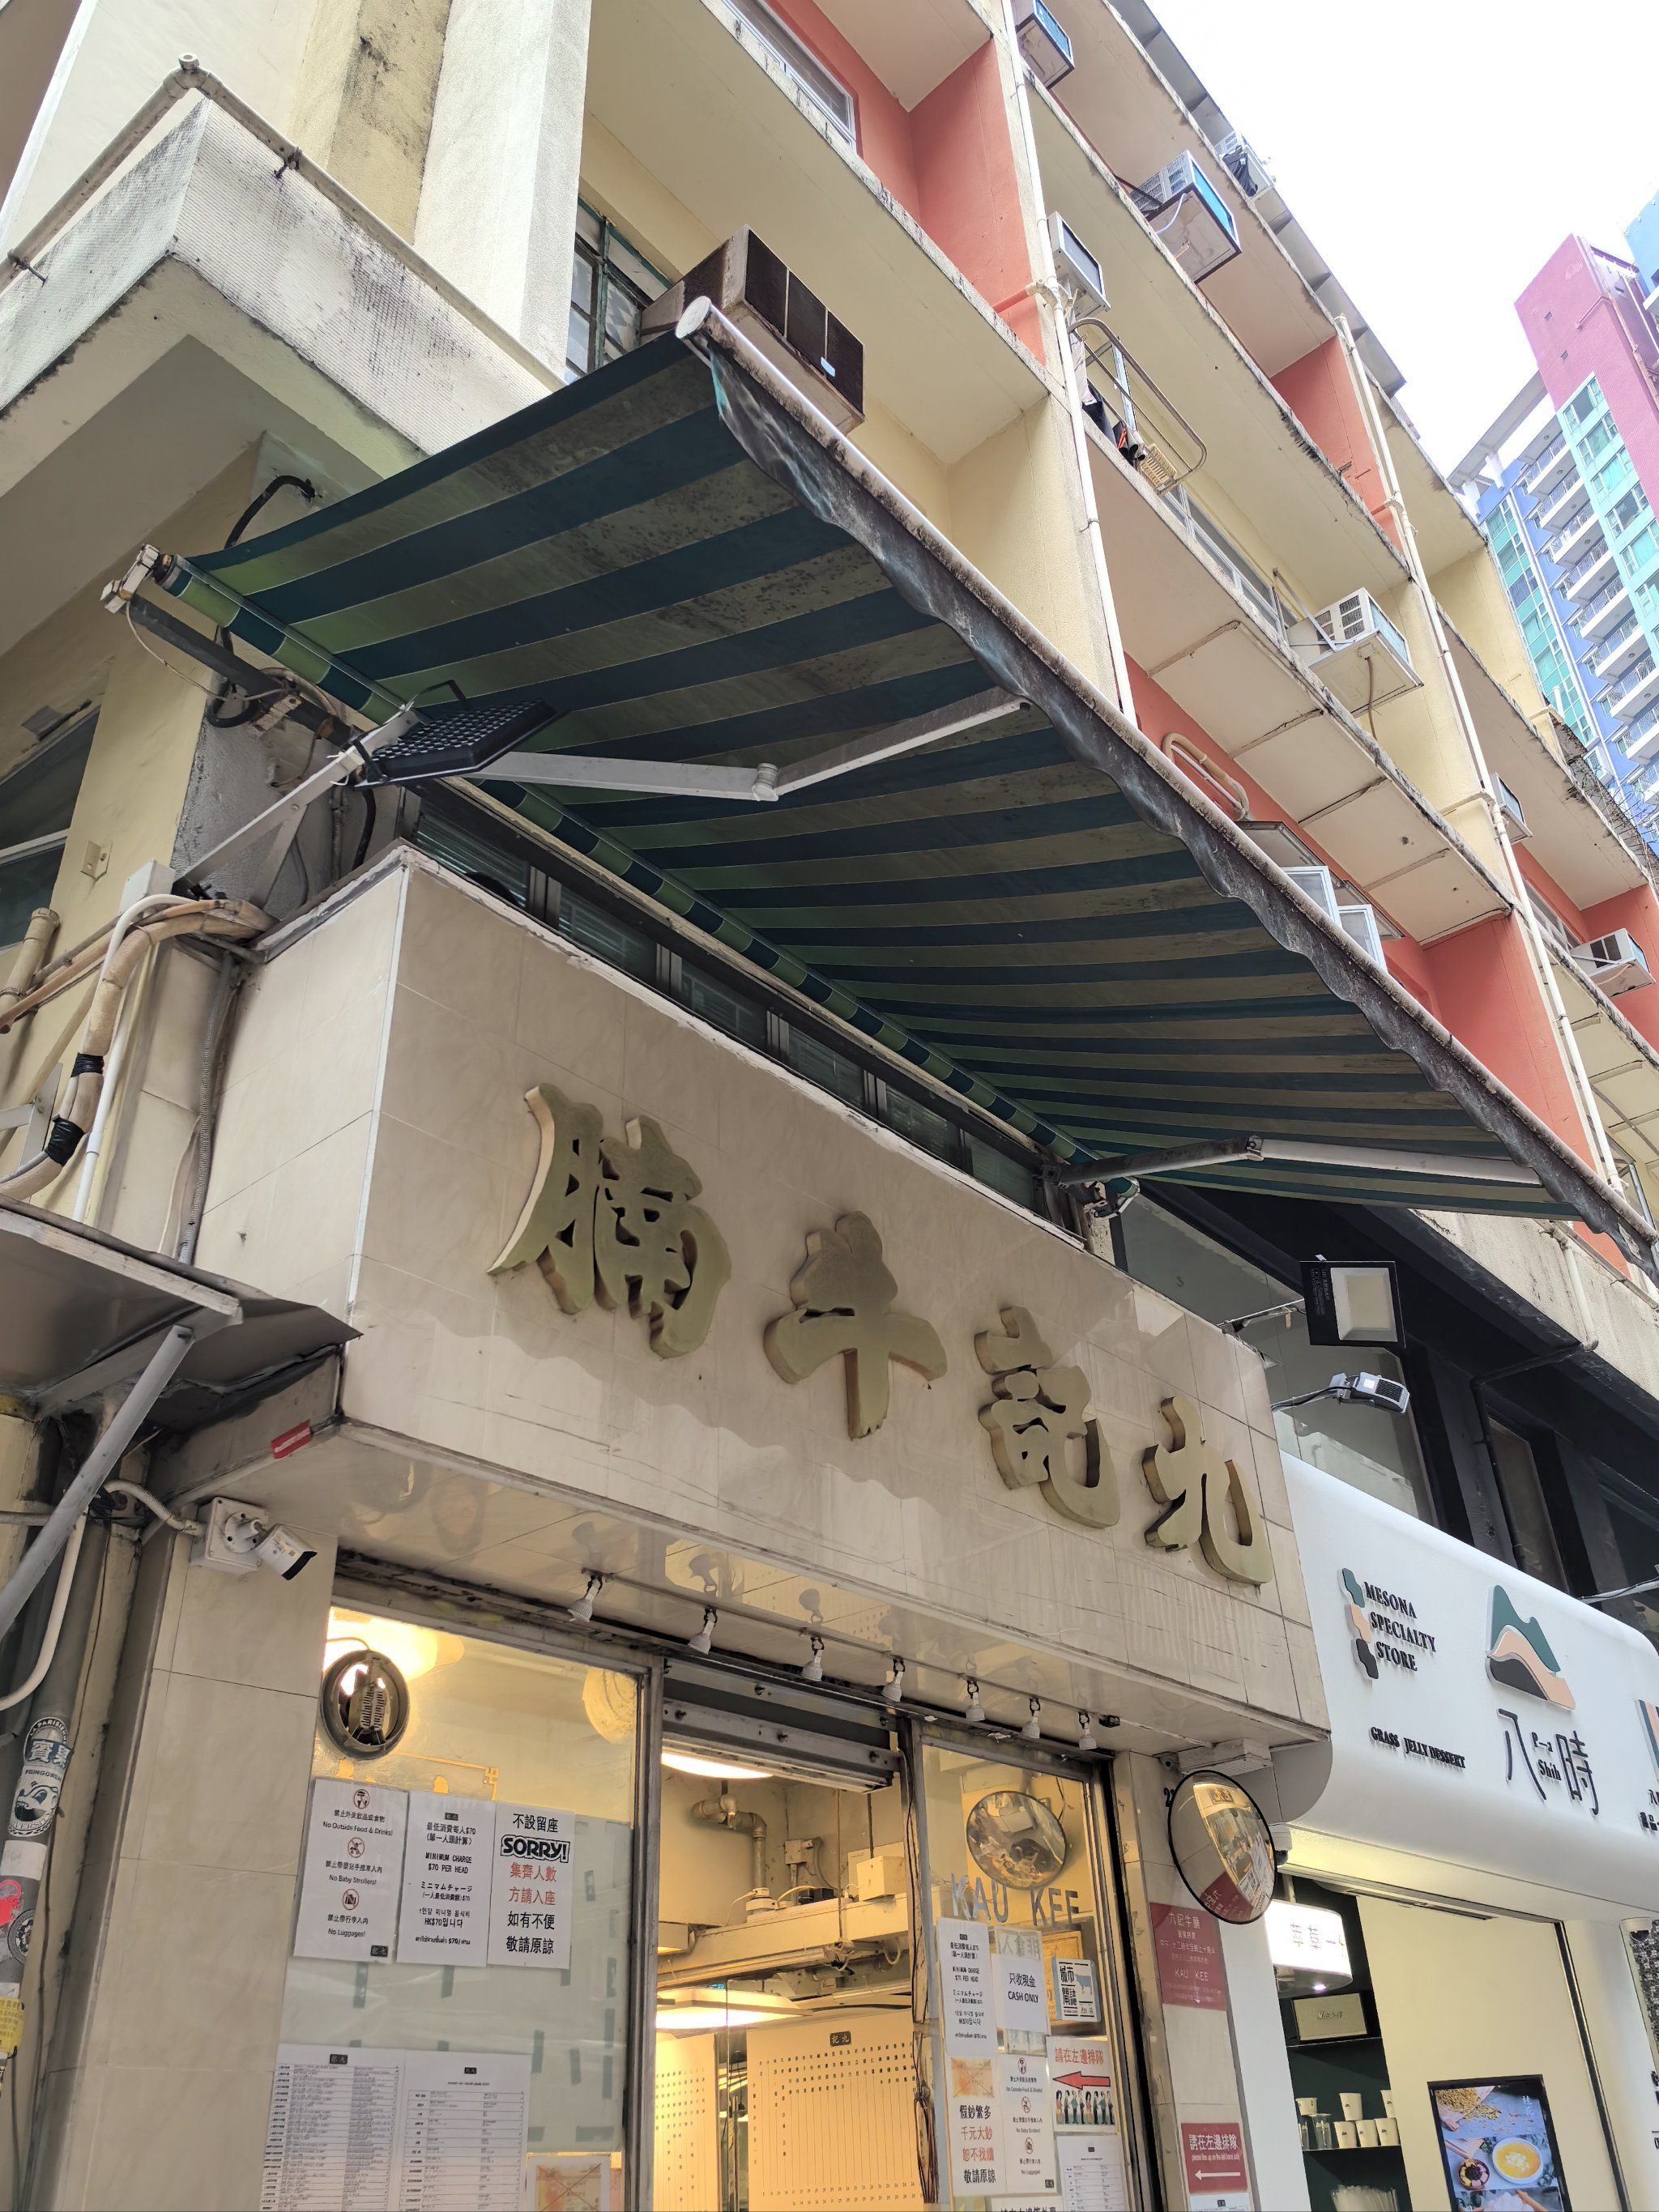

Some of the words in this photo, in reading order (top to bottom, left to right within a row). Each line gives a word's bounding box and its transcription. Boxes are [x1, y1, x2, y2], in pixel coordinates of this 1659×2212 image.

[1364, 1582, 1417, 1619] MESONA
[1370, 1611, 1436, 1652] SPECIALTY
[1375, 1641, 1418, 1672] STORE
[1371, 1726, 1401, 1748] GRASS
[1403, 1737, 1430, 1757] JELLY
[1429, 1745, 1466, 1769] DESSERT
[1498, 1708, 1599, 1815] 八時
[1538, 1759, 1562, 1781] Shih
[332, 1822, 353, 1831] Outside
[354, 1825, 368, 1833] Food
[374, 1828, 393, 1836] Drinks!
[513, 1813, 559, 1833] 不設留座
[502, 1836, 569, 1861] SORRY!
[425, 1852, 450, 1862] MINIMUM
[452, 1855, 472, 1864] CHARGE
[428, 1863, 439, 1871] $70
[441, 1865, 452, 1873] PER
[454, 1865, 469, 1873] HEAD
[510, 1861, 557, 1883] 集齊人數
[339, 1875, 352, 1884] Baby
[352, 1877, 377, 1886] Strollers!
[421, 1881, 473, 1892] ミニマムチャージ
[509, 1886, 556, 1906] 方請入座
[951, 1873, 1009, 1924] KAU
[507, 1910, 556, 1930] 如有不便
[337, 1929, 365, 1938] Luggages!
[505, 1935, 554, 1954] 敬請原諒
[1009, 1972, 1036, 1988] 只收現金
[1175, 1969, 1188, 1978] KAU
[1195, 1971, 1209, 1981] KEE
[1008, 1991, 1023, 2001] CASH
[1024, 1993, 1039, 2003] ONLY
[1055, 2047, 1104, 2065] 請在左邊排隊
[959, 2104, 992, 2120] 假鈔繁多
[961, 2126, 992, 2141] 千元大鈔
[963, 2168, 996, 2184] 敬請原諒
